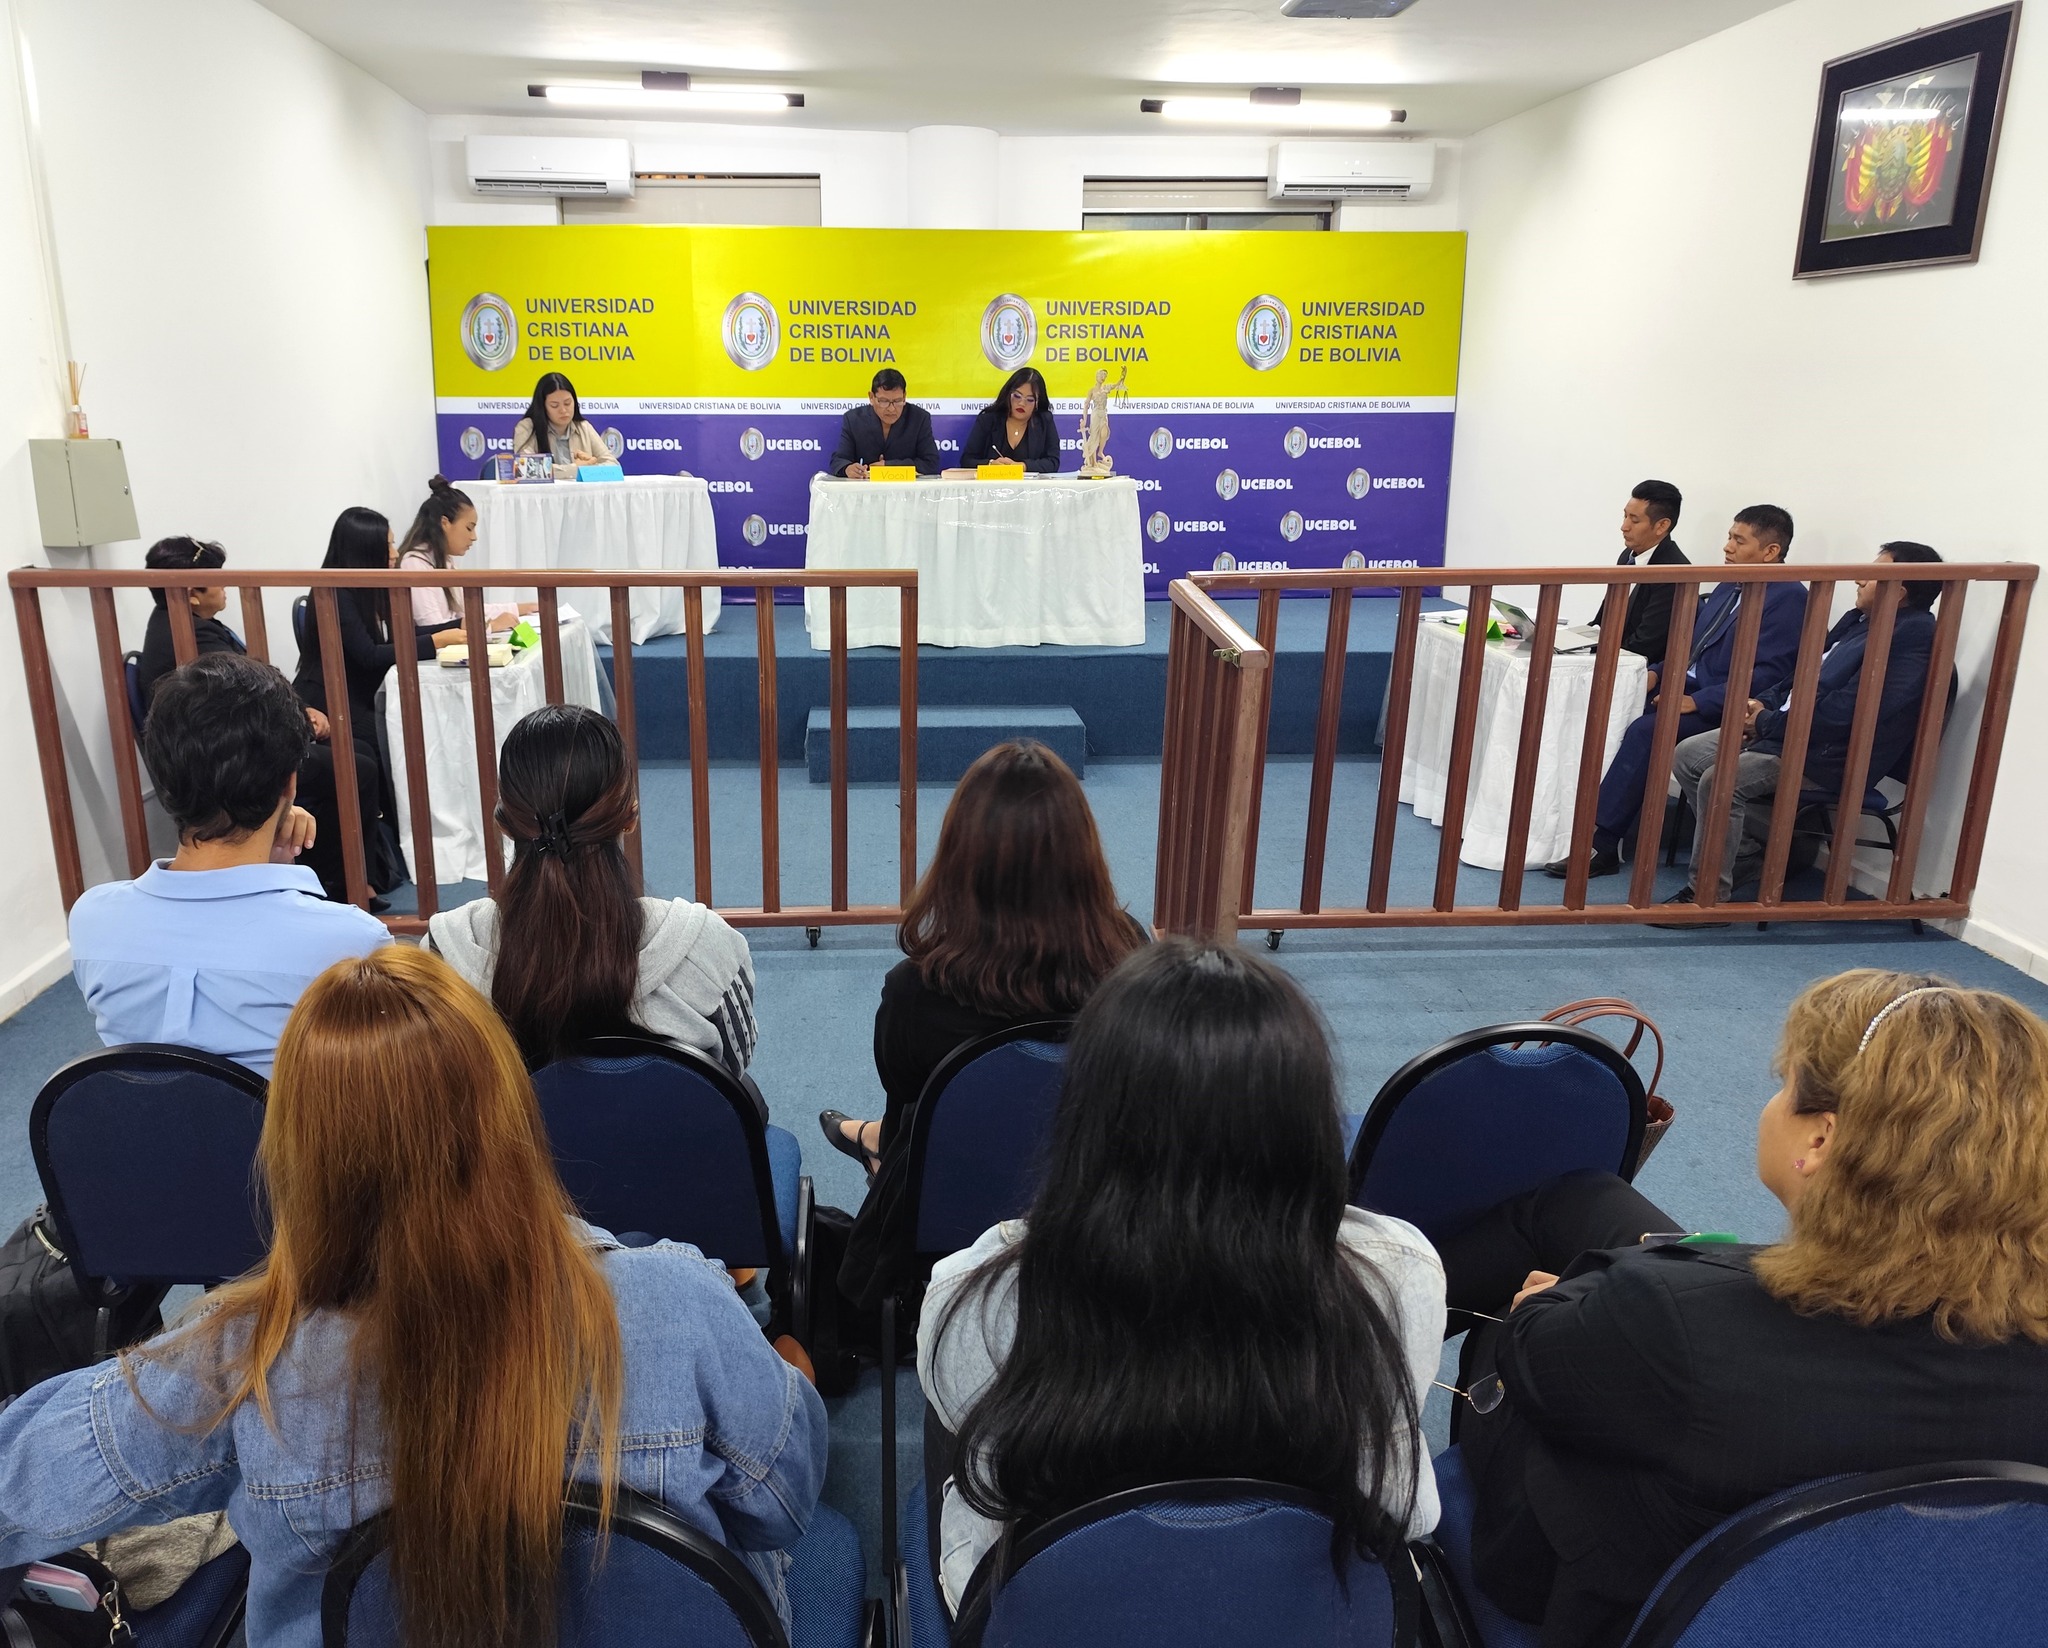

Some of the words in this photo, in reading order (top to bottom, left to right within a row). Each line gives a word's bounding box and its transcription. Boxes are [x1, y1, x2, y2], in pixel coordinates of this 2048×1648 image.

[526, 298, 655, 314] UNIVERSIDAD
[788, 300, 917, 316] UNIVERSIDAD
[1046, 300, 1172, 316] UNIVERSIDAD
[1302, 301, 1425, 317] UNIVERSIDAD
[527, 321, 629, 338] CRISTIANA
[789, 323, 891, 340] CRISTIANA
[1046, 324, 1145, 339] CRISTIANA
[1300, 324, 1398, 340] CRISTIANA
[528, 345, 554, 361] DE
[559, 345, 636, 361] BOLIVIA
[790, 347, 815, 363] DE
[821, 347, 896, 363] BOLIVIA
[1046, 347, 1070, 362] DE
[1076, 347, 1149, 362] BOLIVIA
[1299, 347, 1324, 363] DE
[1329, 347, 1402, 363] BOLIVIA
[588, 401, 620, 410] BOLIVIA
[639, 401, 692, 411] UNIVERSIDAD
[693, 401, 736, 411] CRISTIANA
[737, 401, 748, 411] DE
[749, 401, 782, 411] BOLIVIA
[800, 402, 853, 411] UNIVERSIDAD
[1056, 402, 1067, 411] DE
[1118, 401, 1169, 410] UNIVERSIDAD
[1171, 401, 1212, 410] CRISTIANA
[1213, 401, 1223, 410] DE
[1224, 401, 1255, 410] BOLIVIA
[1275, 401, 1326, 409] UNIVERSIDAD
[1327, 401, 1368, 409] CRISTIANA
[1368, 401, 1379, 409] DE
[1380, 400, 1411, 409] BOLIVIA
[487, 438, 514, 451] UCE
[626, 438, 683, 451] UCEBOL
[766, 438, 822, 451] UCEBOL
[1175, 437, 1229, 450] UCEBOL
[1309, 436, 1362, 449] UCEBOL
[881, 470, 909, 480] Vocal
[708, 481, 754, 493] CEBOL
[1135, 479, 1162, 491] BOL
[1241, 477, 1294, 490] UCEBOL
[1372, 476, 1425, 489] UCEBOL
[1173, 520, 1227, 532] UCEBOL
[1304, 519, 1357, 531] UCEBOL
[1237, 560, 1290, 571] UCEBOL
[1367, 558, 1420, 569] UCEBOL
